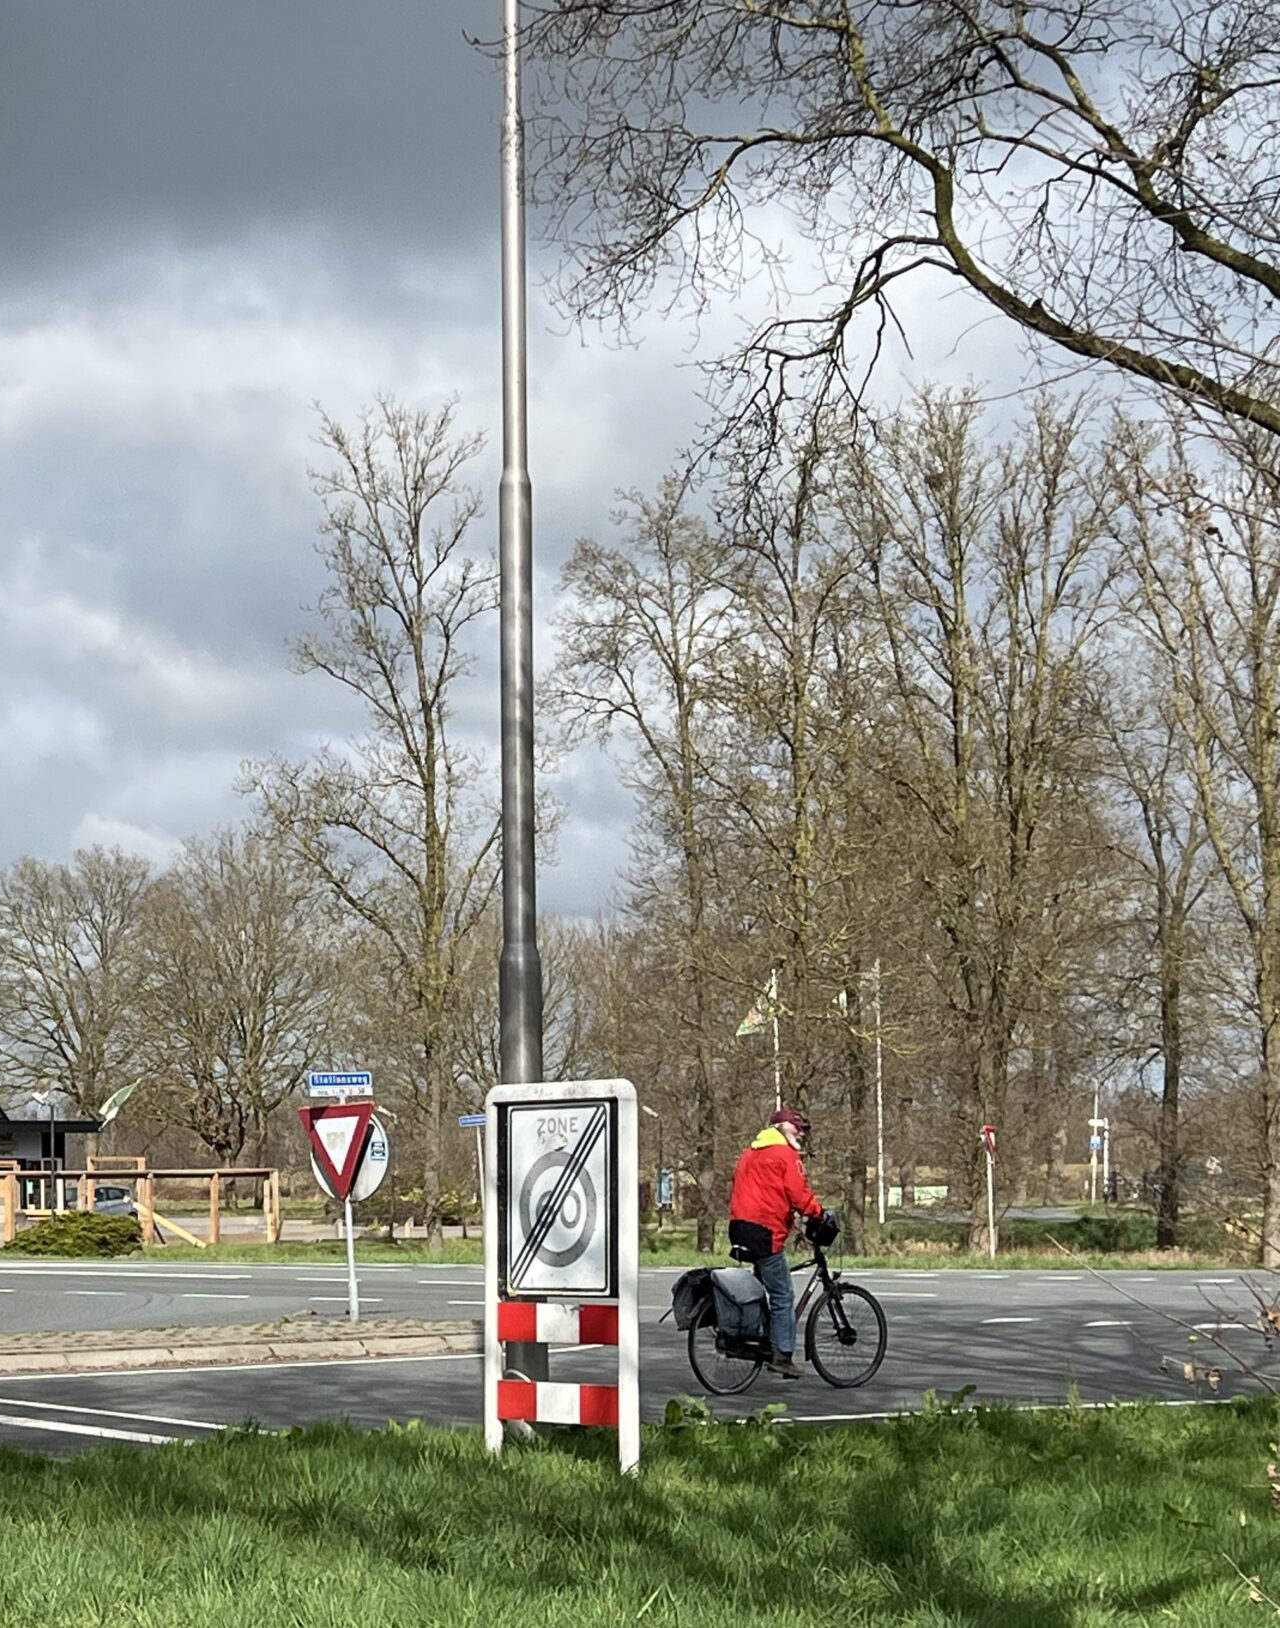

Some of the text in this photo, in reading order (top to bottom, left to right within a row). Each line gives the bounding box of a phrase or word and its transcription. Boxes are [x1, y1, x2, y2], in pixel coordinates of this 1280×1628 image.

[313, 1075, 368, 1086] Stationsweg
[537, 1116, 579, 1134] ZONE
[535, 1189, 581, 1230] 60
